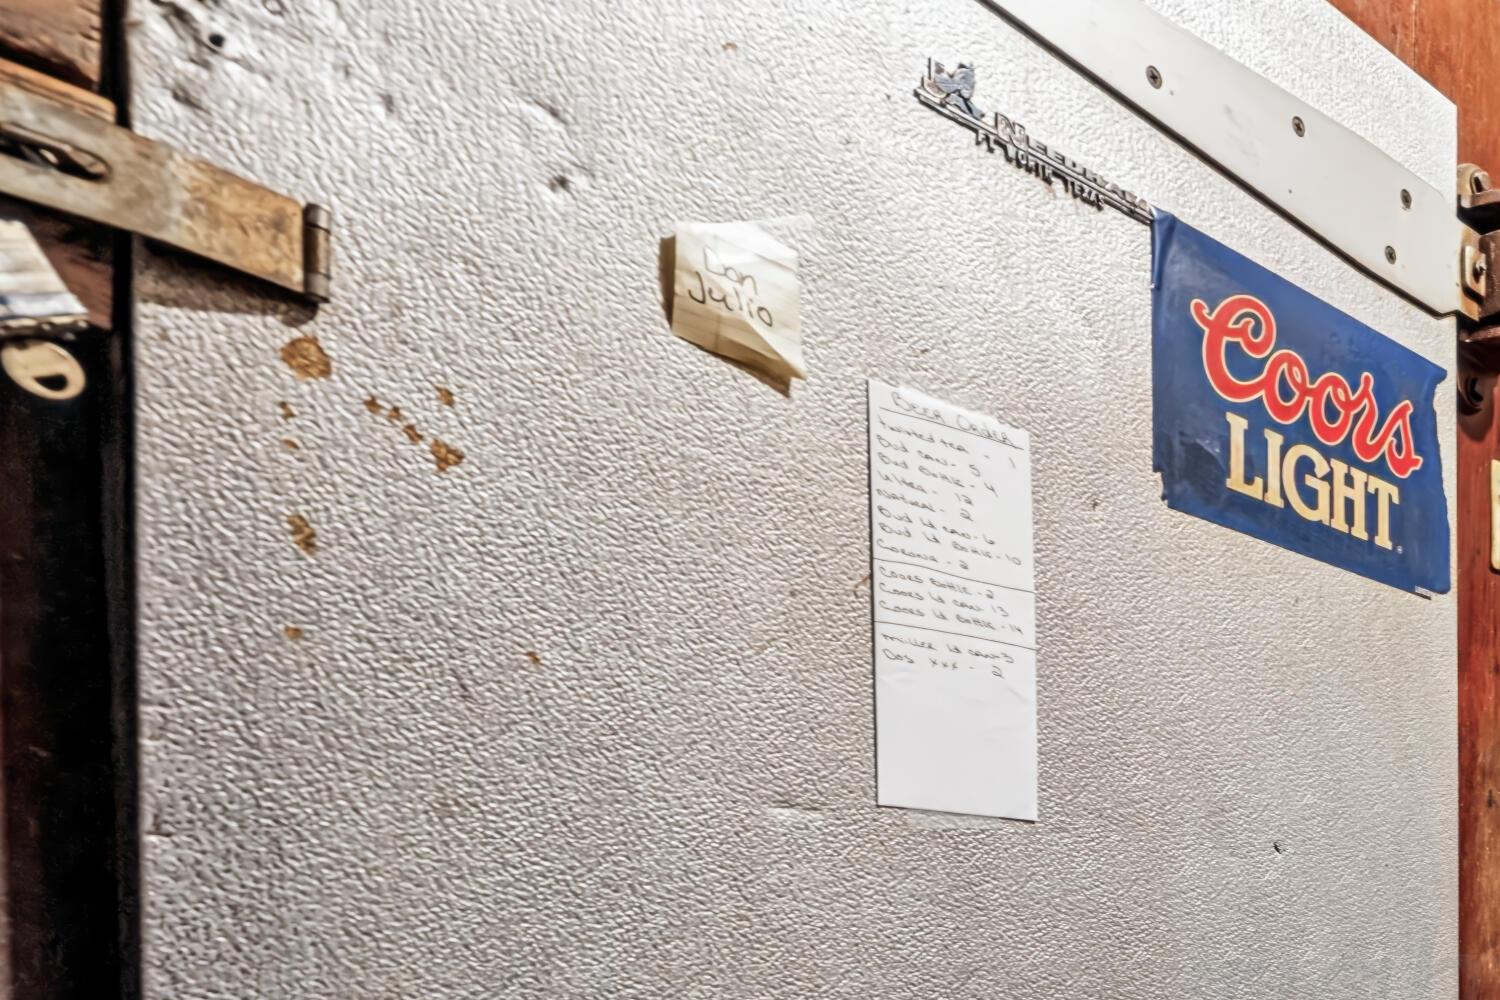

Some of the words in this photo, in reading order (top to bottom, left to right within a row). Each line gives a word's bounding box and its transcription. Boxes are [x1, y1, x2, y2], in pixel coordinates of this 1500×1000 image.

[688, 271, 773, 327] Julio
[1190, 295, 1423, 478] Coors
[1226, 412, 1399, 550] LIGHT
